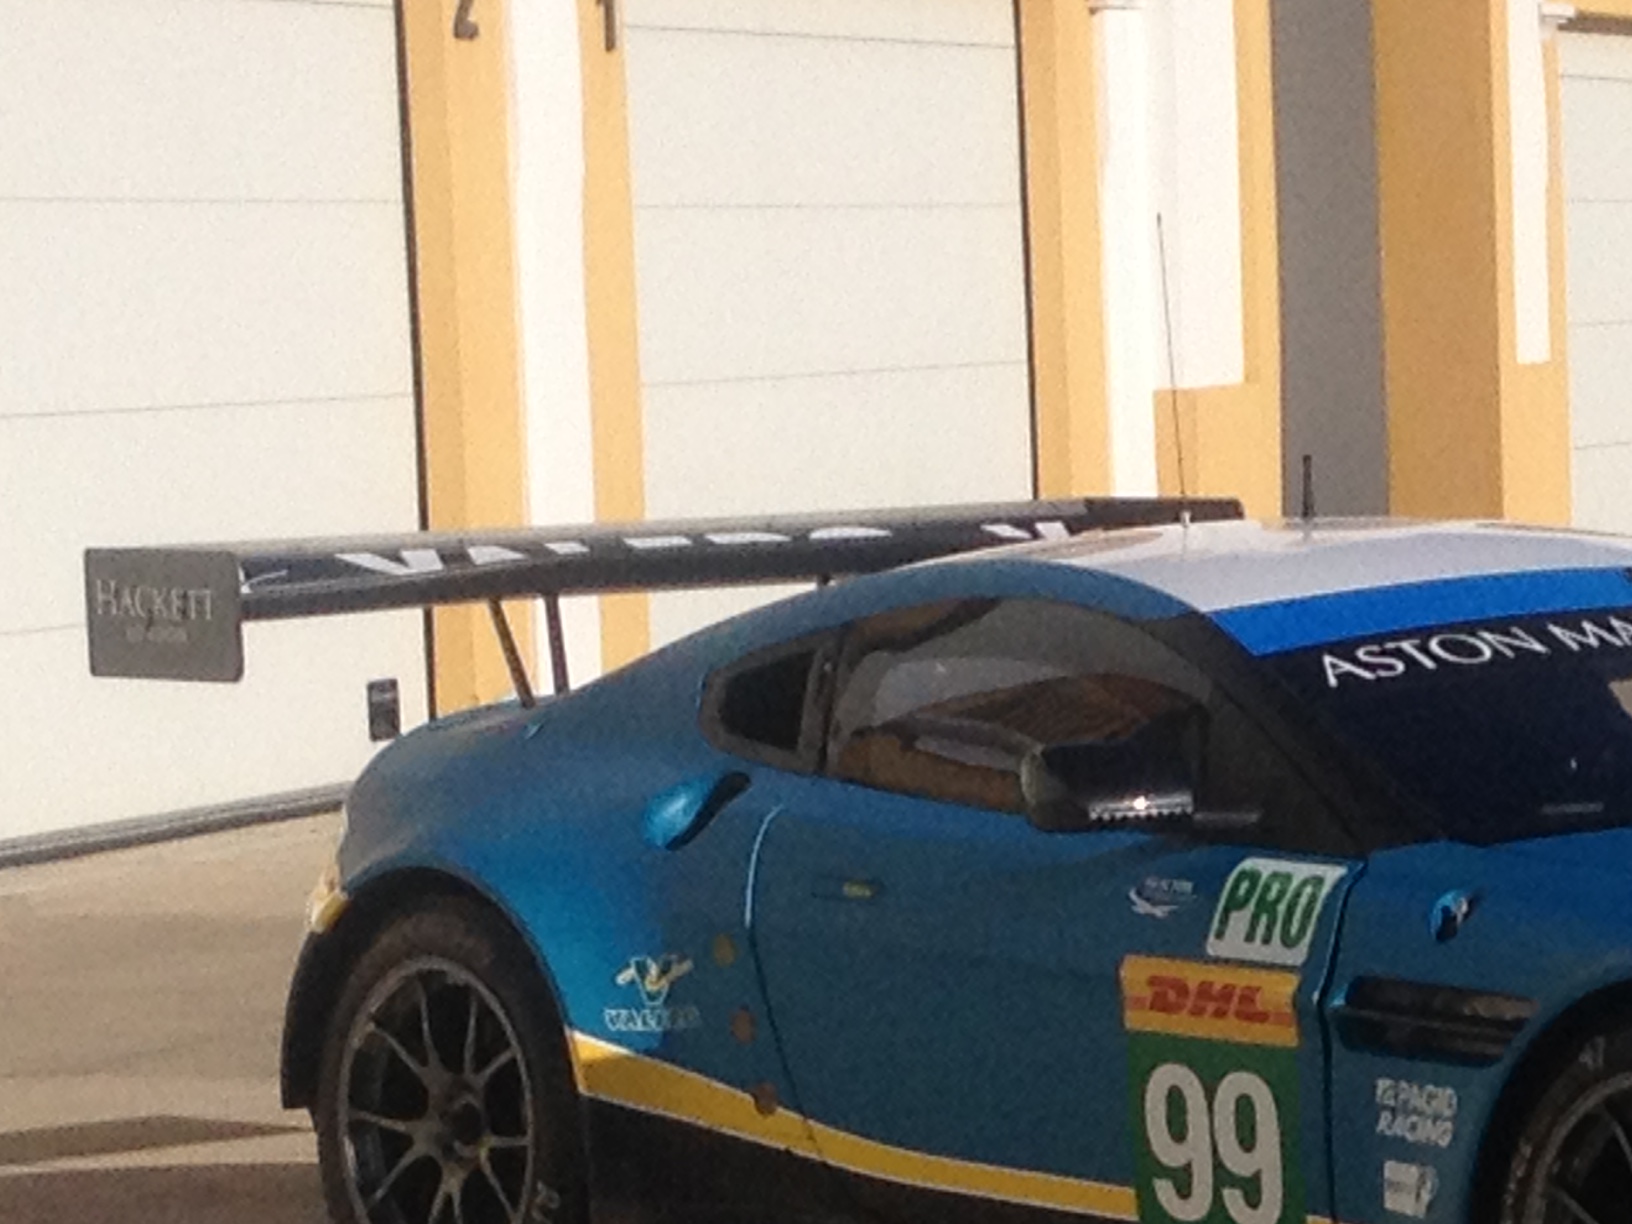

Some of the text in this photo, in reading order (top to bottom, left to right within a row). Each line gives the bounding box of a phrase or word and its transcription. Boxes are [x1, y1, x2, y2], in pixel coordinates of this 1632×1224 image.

[96, 579, 212, 620] HACKETT
[1321, 626, 1549, 687] ASTON
[1213, 868, 1325, 947] PRO
[1146, 975, 1270, 1024] DHL
